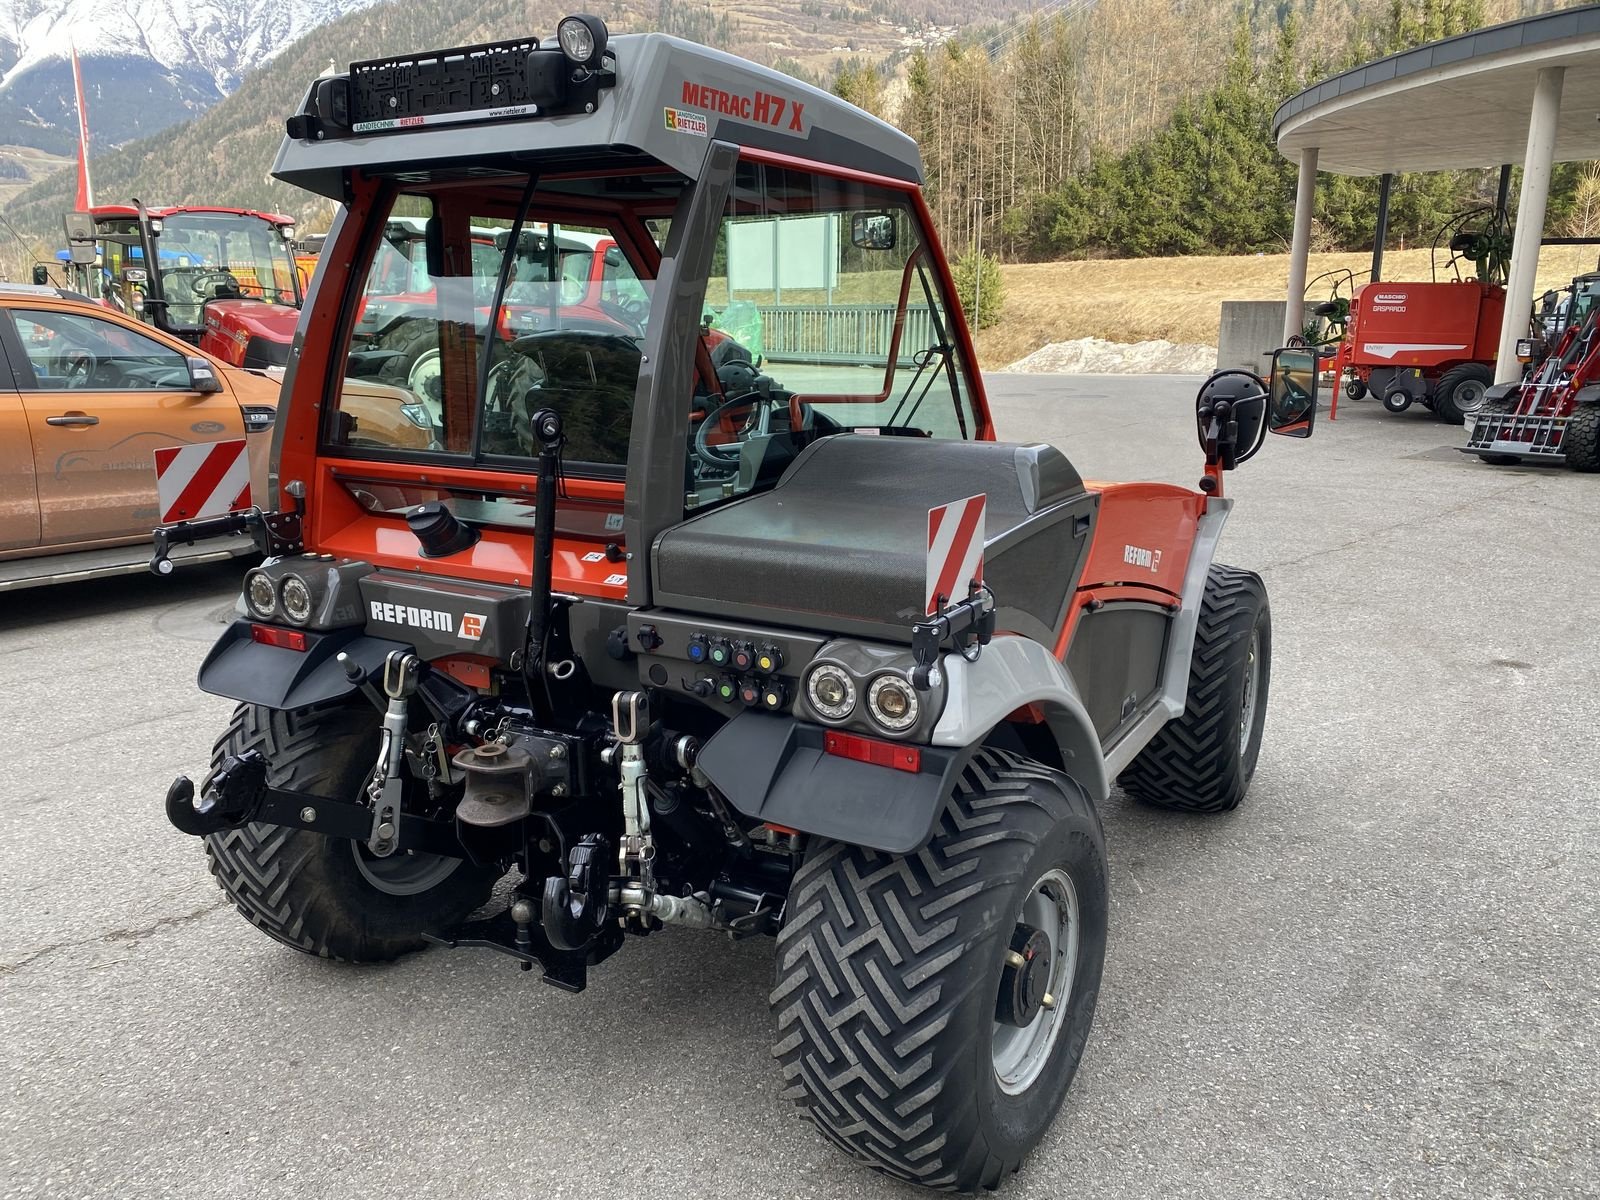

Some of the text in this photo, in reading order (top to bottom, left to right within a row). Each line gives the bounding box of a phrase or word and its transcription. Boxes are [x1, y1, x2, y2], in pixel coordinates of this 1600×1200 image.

[682, 80, 805, 132] METRAC H7 X
[356, 117, 425, 131] LANDTECHNIK RIETZLER
[677, 118, 706, 132] RIETZLER
[1124, 544, 1152, 568] REFORM
[370, 600, 453, 632] REFORM
